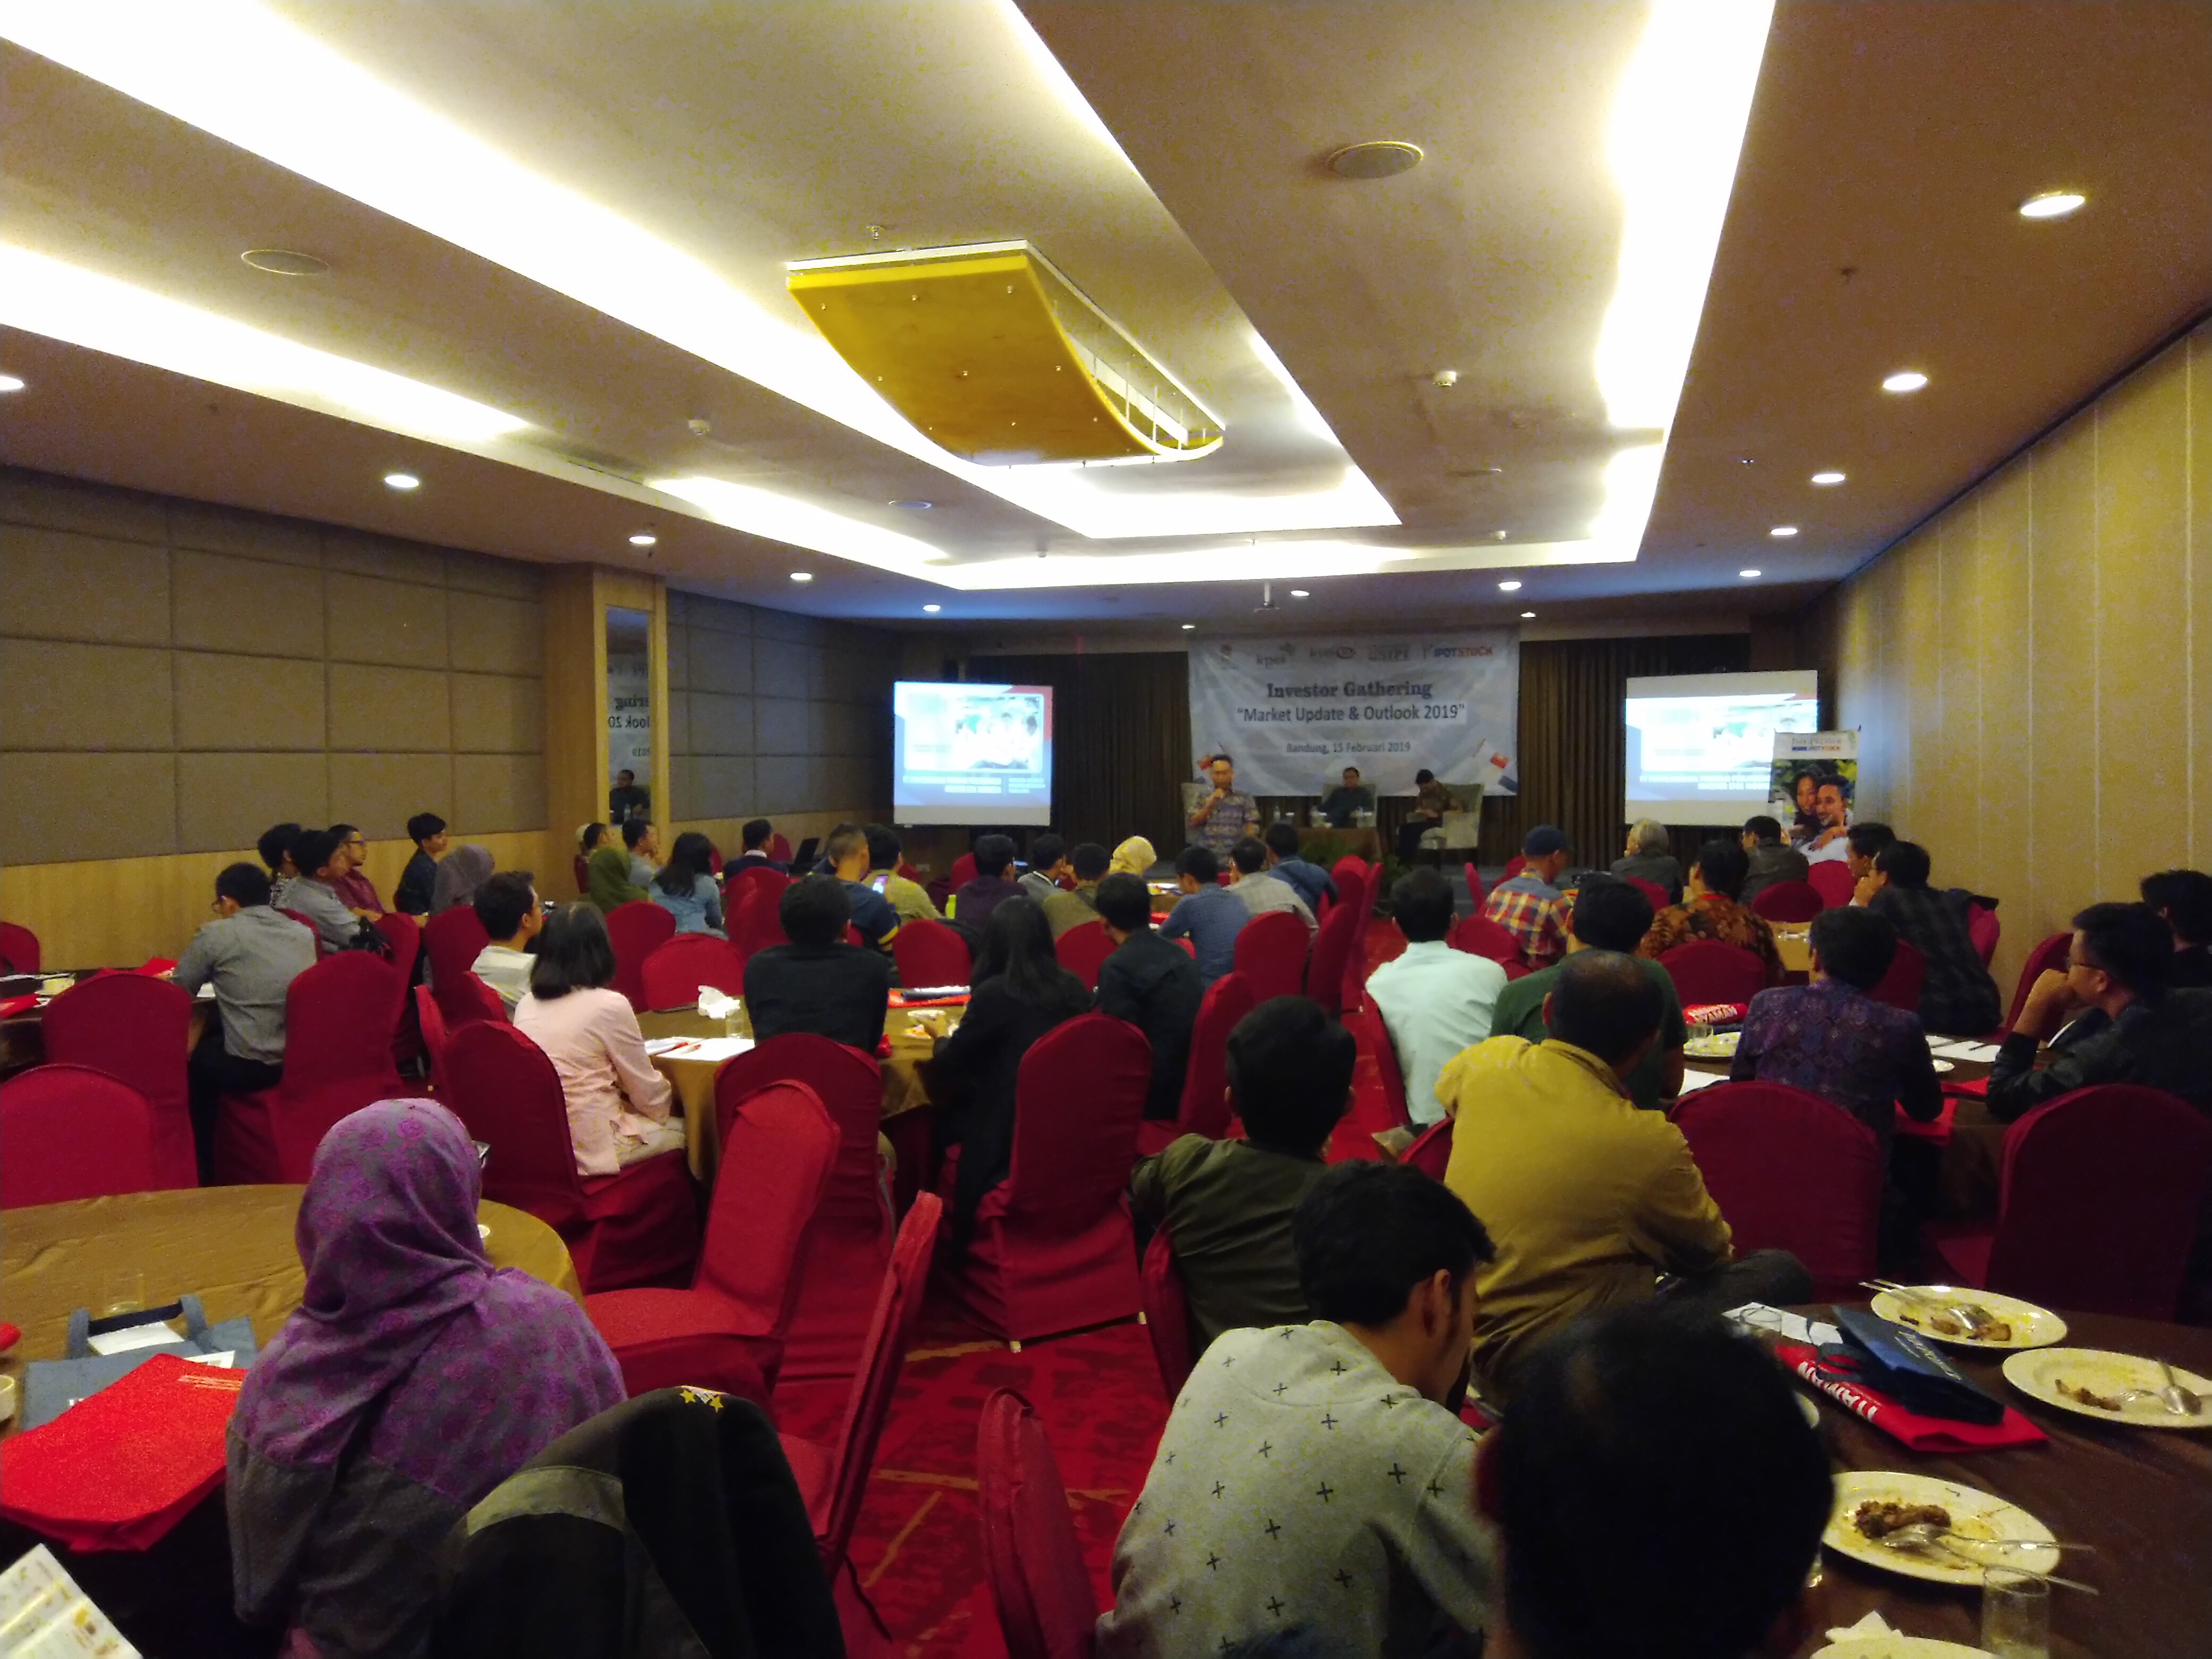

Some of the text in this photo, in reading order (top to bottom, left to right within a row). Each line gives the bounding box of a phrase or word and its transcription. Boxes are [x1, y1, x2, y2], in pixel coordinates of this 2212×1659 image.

[1267, 681, 1432, 700] Investor Gathering
[1296, 706, 1344, 724] Update
[1348, 706, 1359, 720] &
[1364, 704, 1419, 720] Outlook
[1334, 743, 1344, 753] 15
[1388, 742, 1411, 752] 2019
